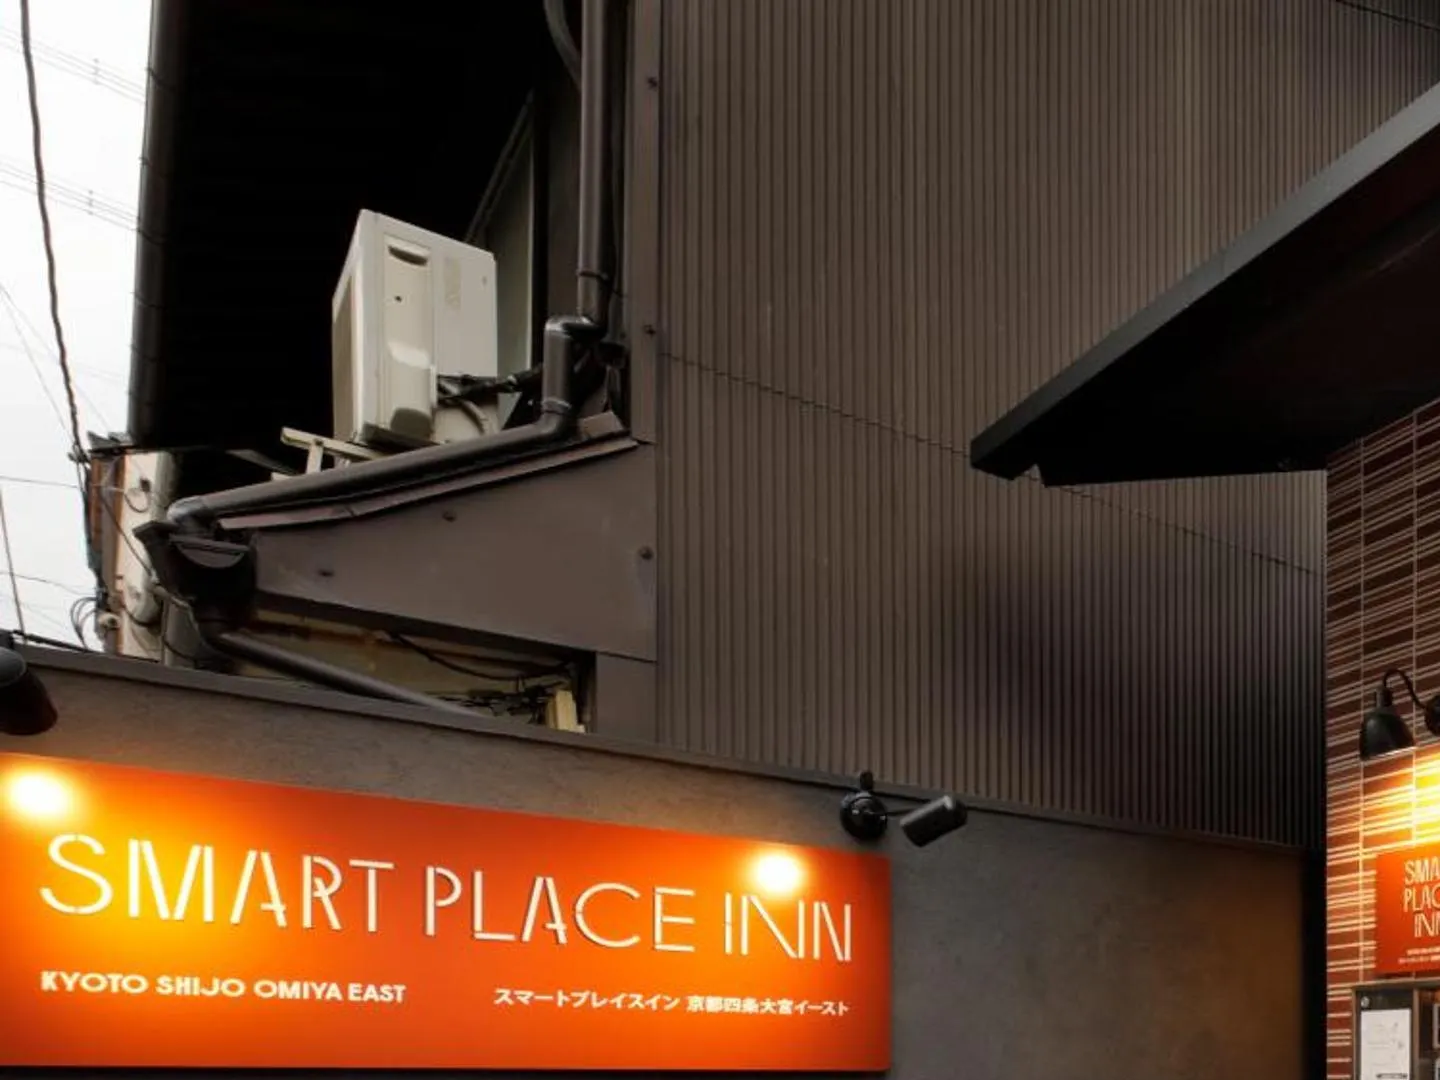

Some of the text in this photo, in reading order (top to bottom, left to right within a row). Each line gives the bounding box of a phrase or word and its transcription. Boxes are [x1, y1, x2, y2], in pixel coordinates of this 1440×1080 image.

[39, 833, 852, 962] SMART PLACE INN
[40, 970, 407, 1003] KYOTO SHIJO OMIYA EAST
